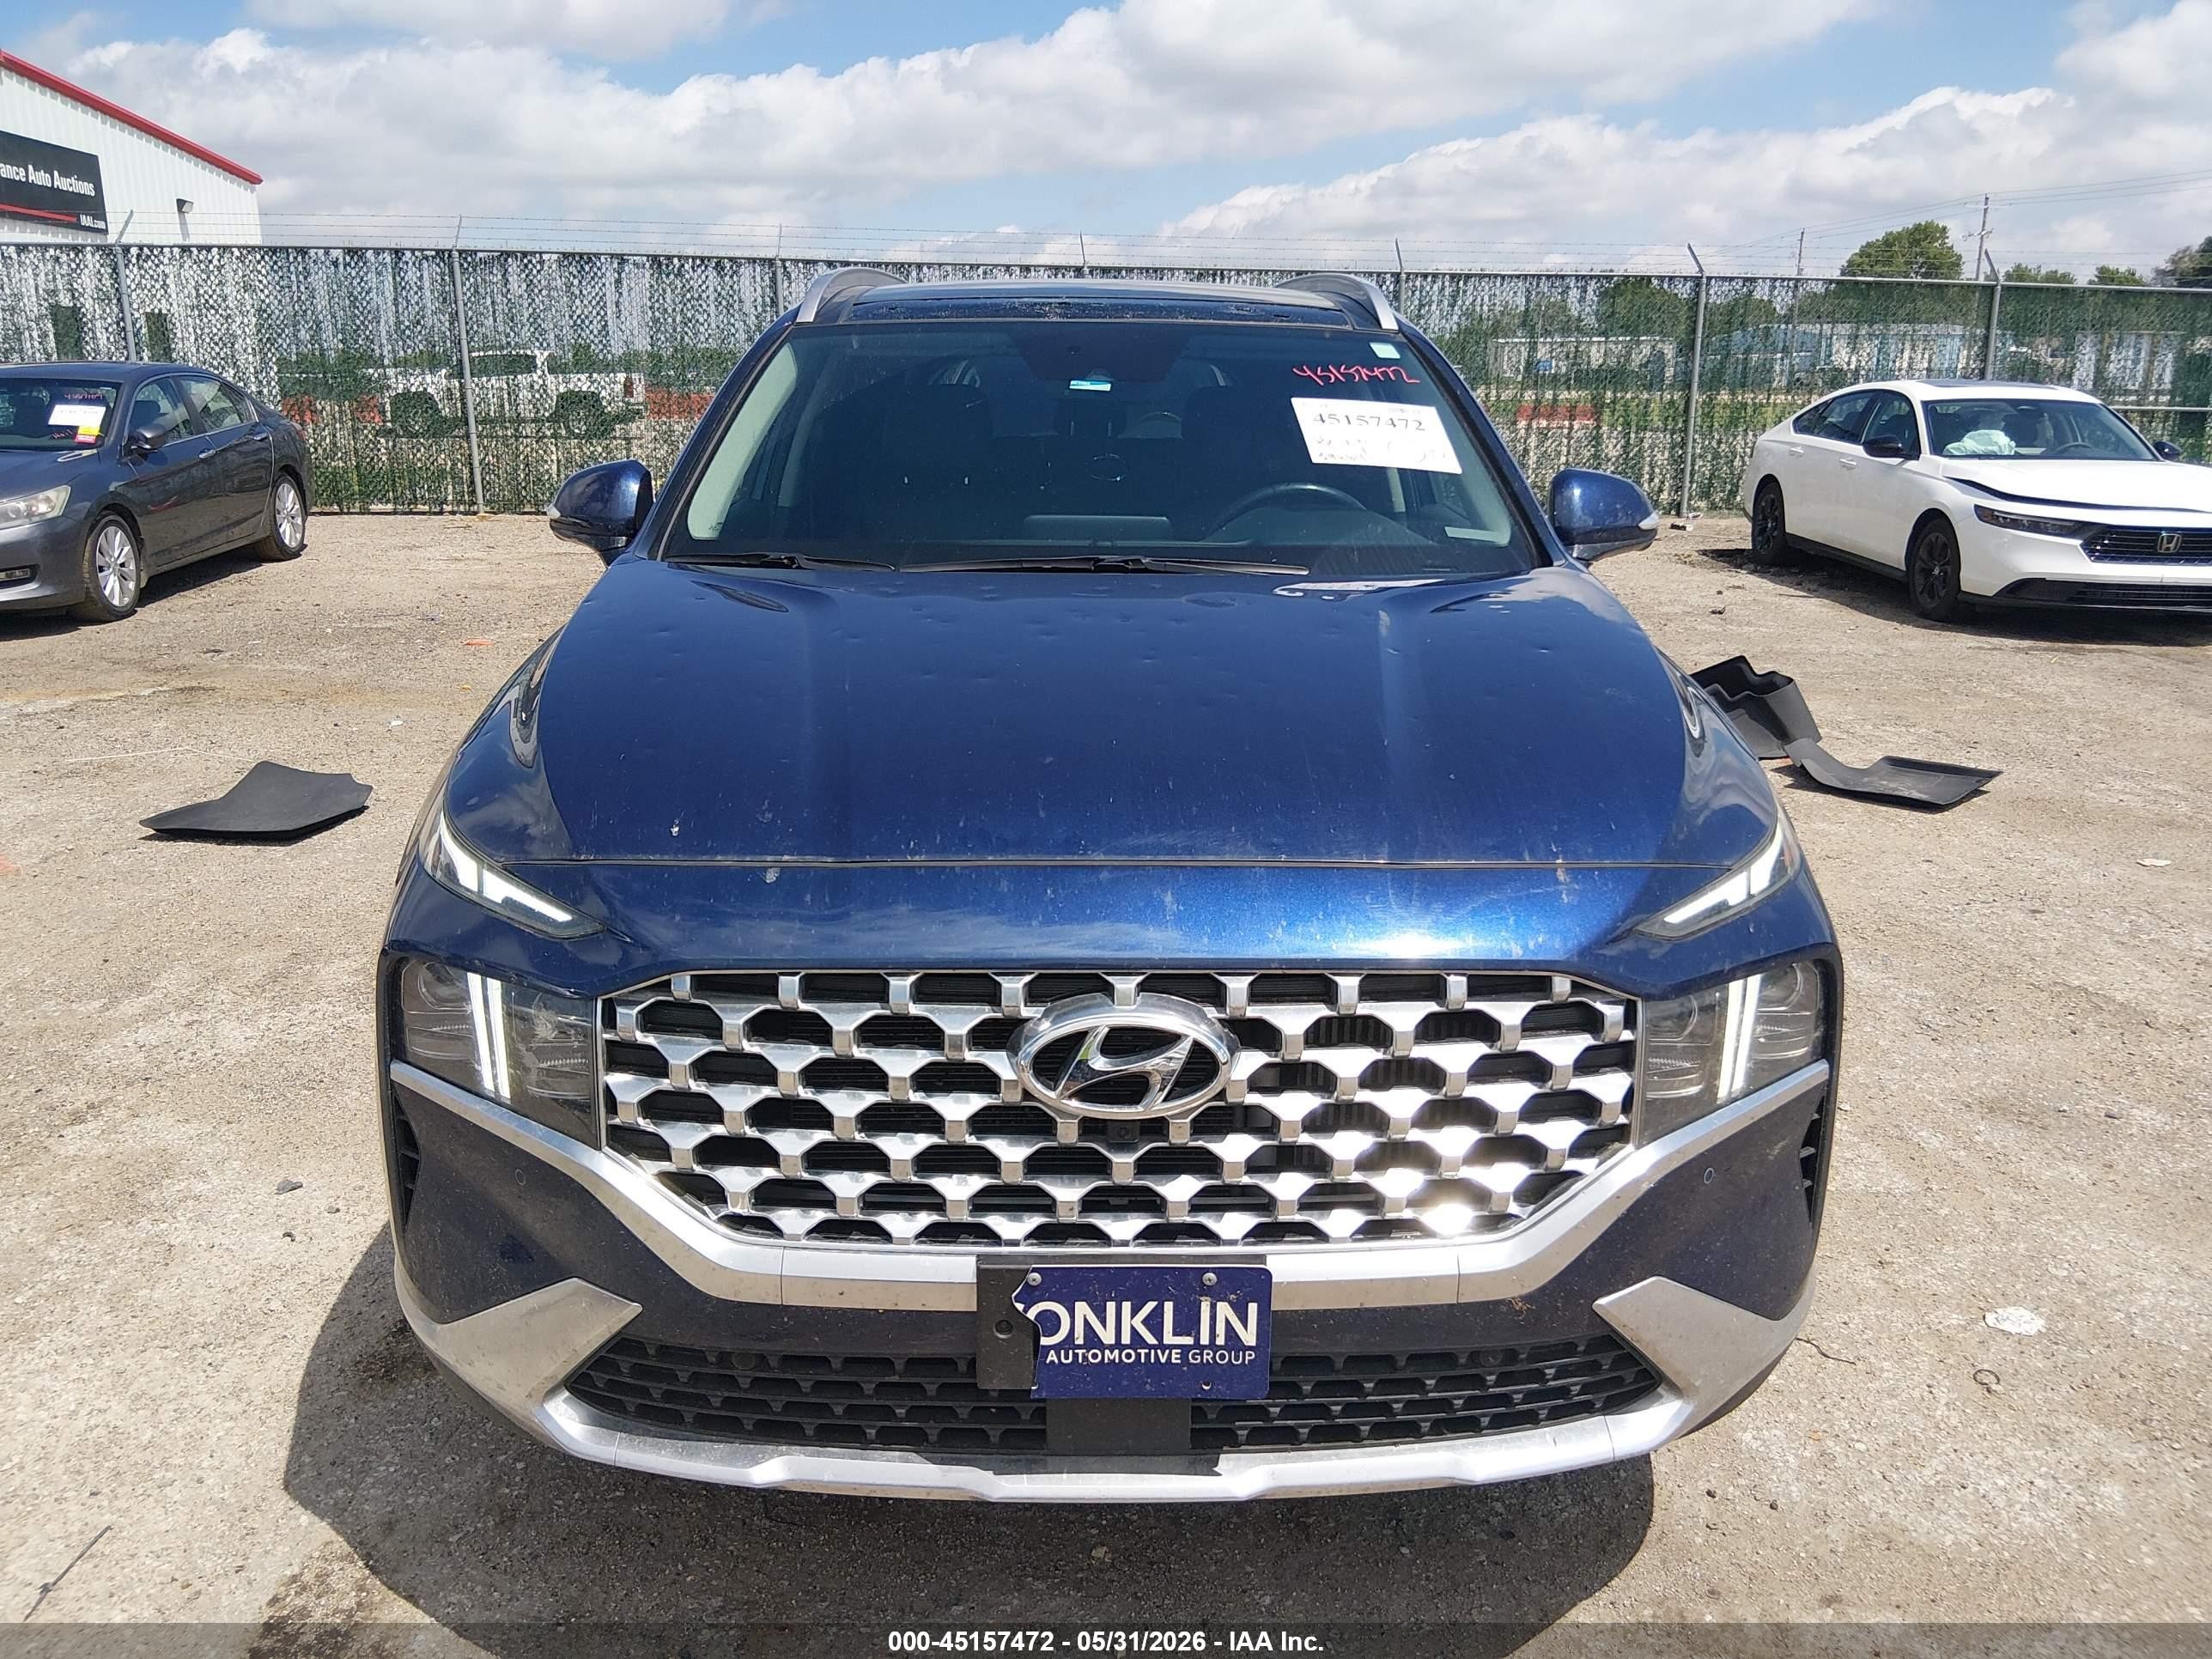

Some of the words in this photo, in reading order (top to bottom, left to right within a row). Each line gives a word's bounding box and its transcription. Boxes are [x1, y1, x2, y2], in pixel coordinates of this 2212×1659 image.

[27, 164, 52, 187] Auto
[53, 170, 95, 197] Auctions
[1313, 413, 1425, 431] 45157472
[1015, 1301, 1259, 1346] ONKLIN
[1045, 1348, 1182, 1364] AUTOMOTIVE
[1188, 1349, 1255, 1365] GROUP
